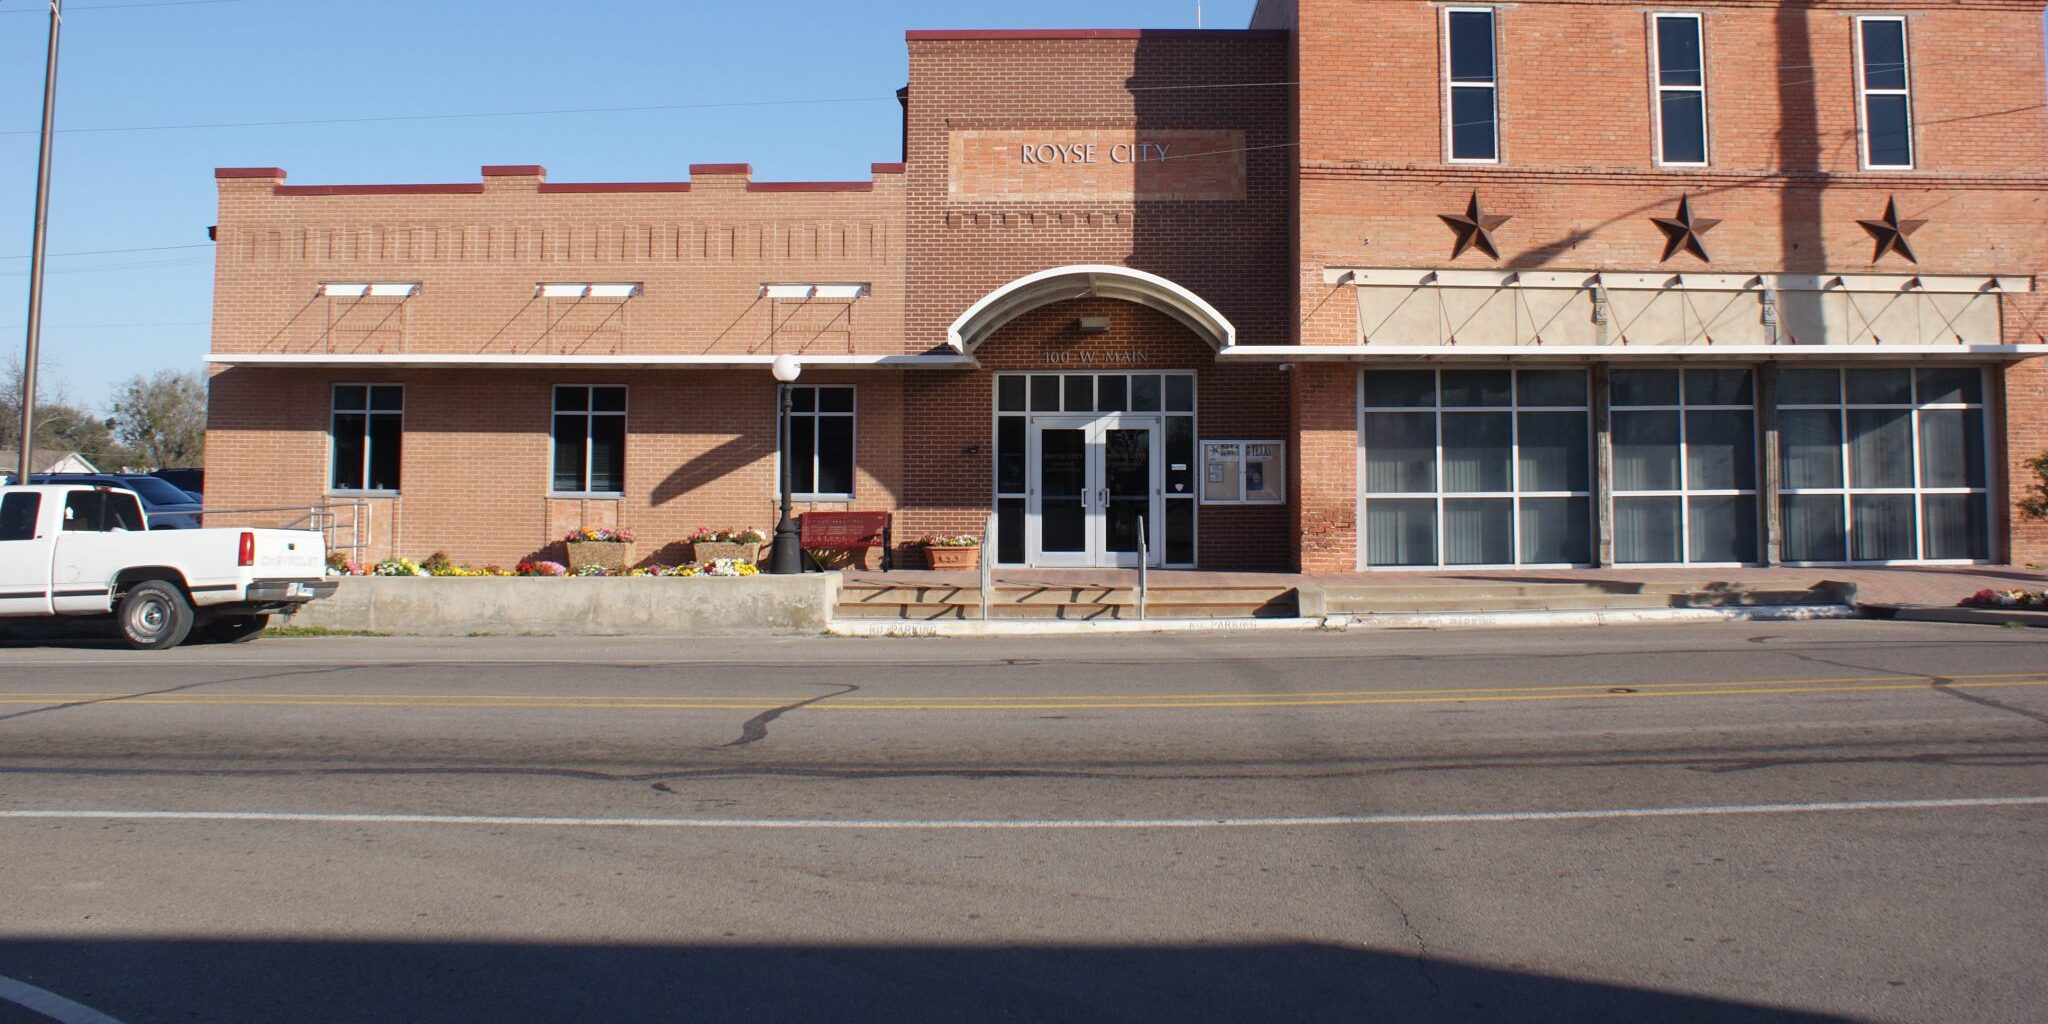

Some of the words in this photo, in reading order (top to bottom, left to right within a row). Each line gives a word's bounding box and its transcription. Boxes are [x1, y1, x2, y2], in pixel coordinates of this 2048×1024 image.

[1021, 143, 1096, 163] ROYSE
[1110, 143, 1170, 163] CITY
[1045, 351, 1069, 363] 100
[1079, 351, 1095, 363] W
[1105, 350, 1148, 362] MAIN
[261, 555, 319, 567] CHEVROLET
[891, 623, 937, 635] PARKING
